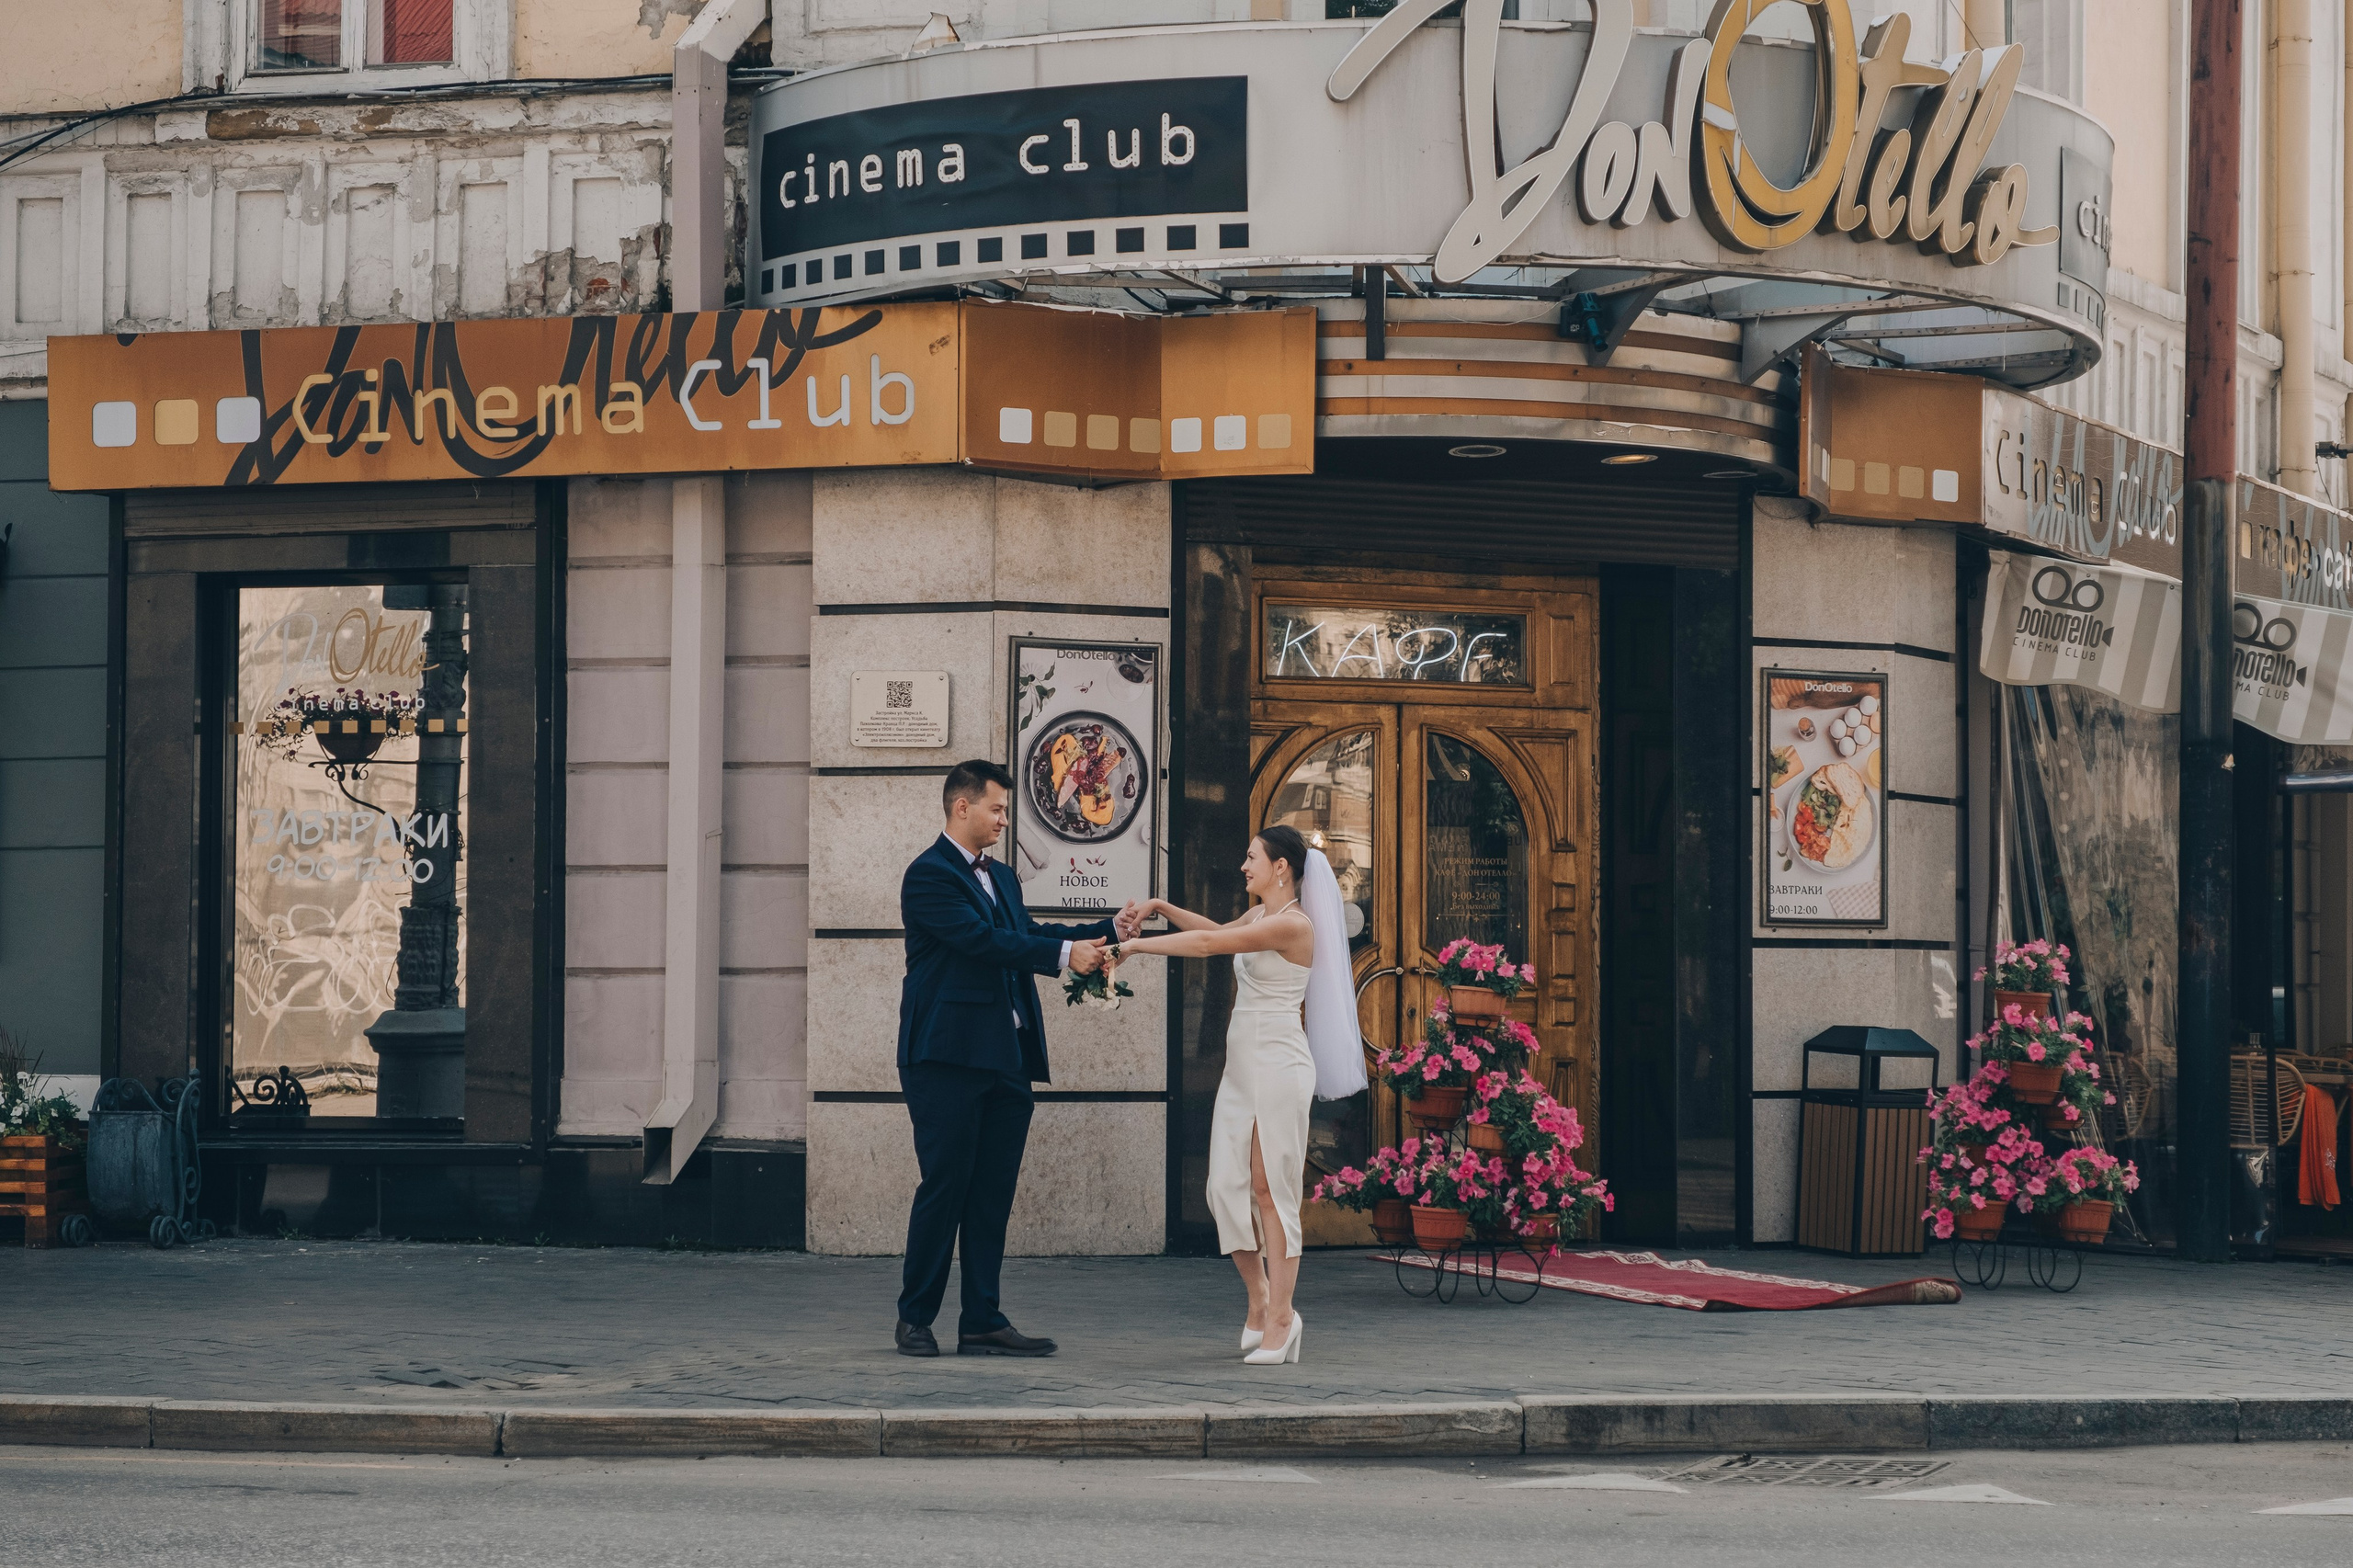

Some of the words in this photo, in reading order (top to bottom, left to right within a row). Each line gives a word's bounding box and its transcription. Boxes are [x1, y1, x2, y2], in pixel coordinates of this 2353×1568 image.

[779, 143, 966, 209] cinema
[1018, 112, 1196, 175] club
[1056, 649, 1116, 661] DonOtello
[2012, 636, 2059, 653] CINEMA
[2064, 647, 2097, 662] CLUB
[1804, 681, 1853, 693] DonOtello
[2257, 686, 2290, 701] CLUB
[275, 698, 359, 711] cinema
[370, 695, 426, 710] club
[252, 808, 449, 849] ЗАВТРАКИ
[267, 854, 435, 883] 9:00-12:00
[1475, 858, 1507, 866] РАБОТЫ
[1060, 875, 1108, 888] НОВОЕ
[1062, 897, 1107, 908] МЕНЮ
[1451, 891, 1500, 901] 9:00-24:00
